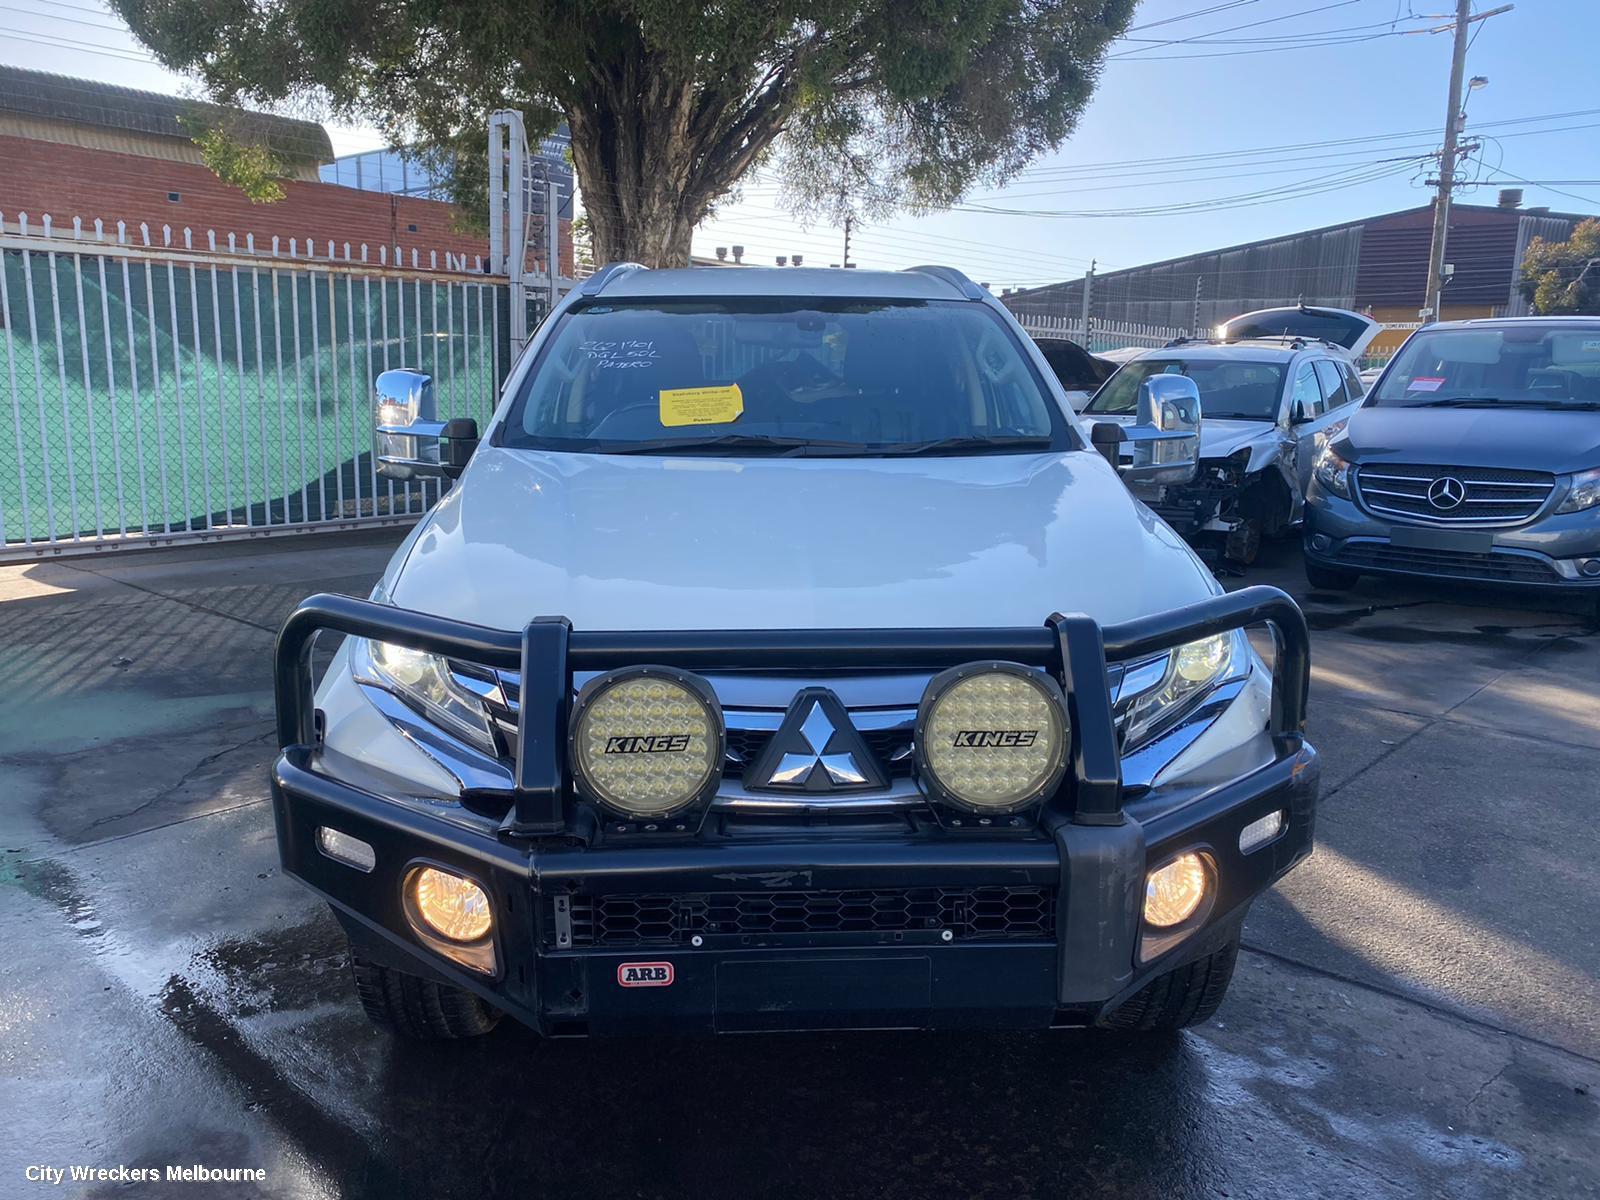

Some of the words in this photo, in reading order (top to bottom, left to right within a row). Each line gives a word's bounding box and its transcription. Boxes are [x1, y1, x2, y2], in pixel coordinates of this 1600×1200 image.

[605, 735, 690, 754] KINGS
[954, 731, 1038, 747] KINGS
[625, 967, 667, 981] ARB
